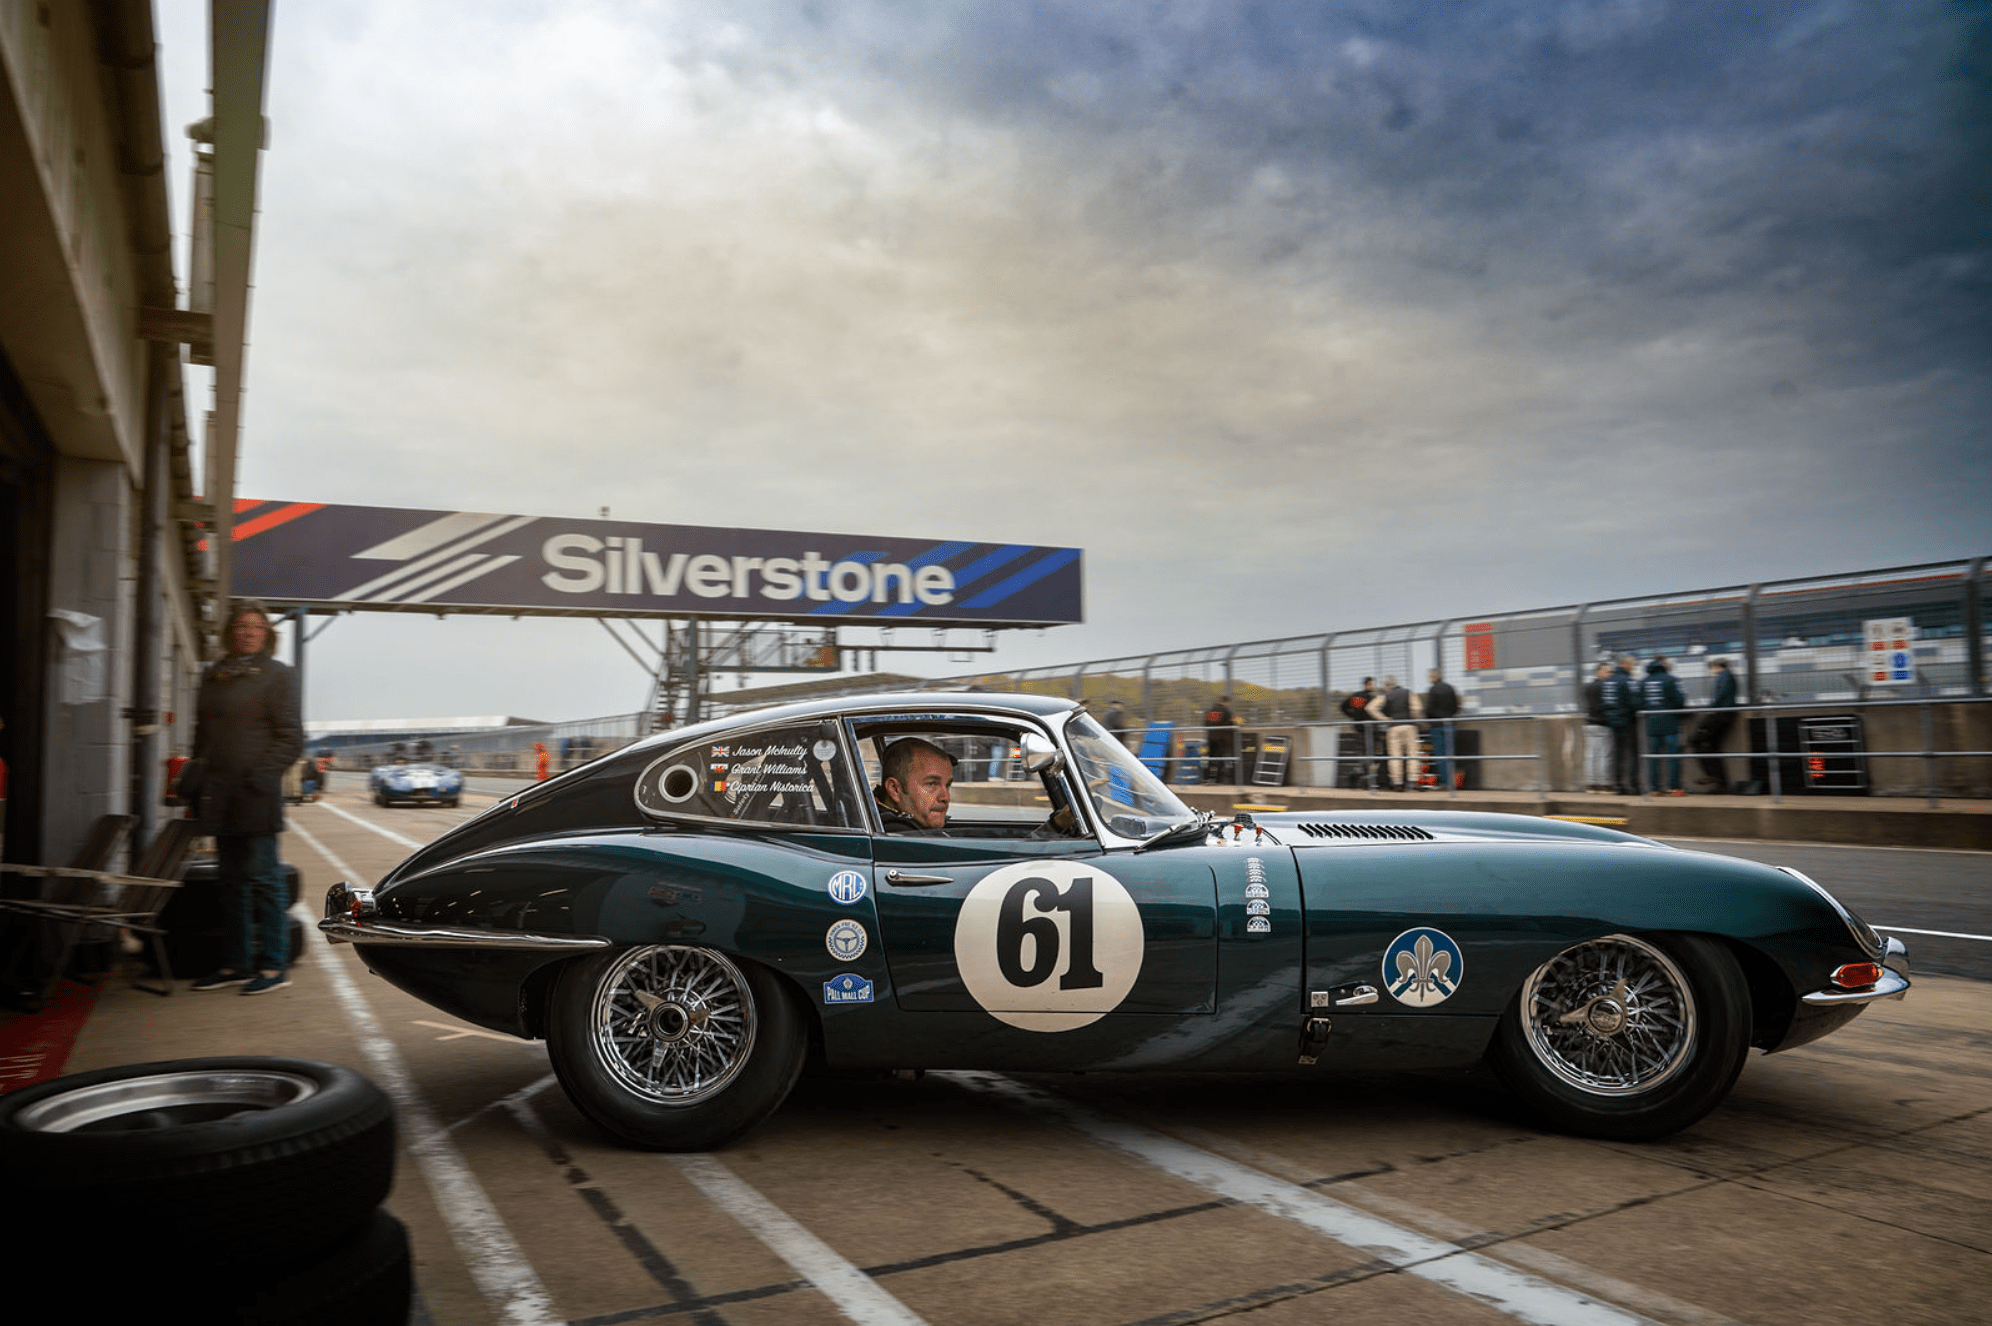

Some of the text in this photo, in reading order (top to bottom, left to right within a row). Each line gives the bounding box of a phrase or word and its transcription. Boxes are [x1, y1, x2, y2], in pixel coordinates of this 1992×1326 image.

[541, 534, 956, 605] Silverstone
[732, 745, 763, 757] Jason
[730, 763, 762, 775] Grant
[763, 763, 808, 775] Williams
[729, 780, 815, 795] Ciprian Nistorica
[996, 876, 1103, 991] 61
[826, 984, 871, 1001] PALL MALL CUP
